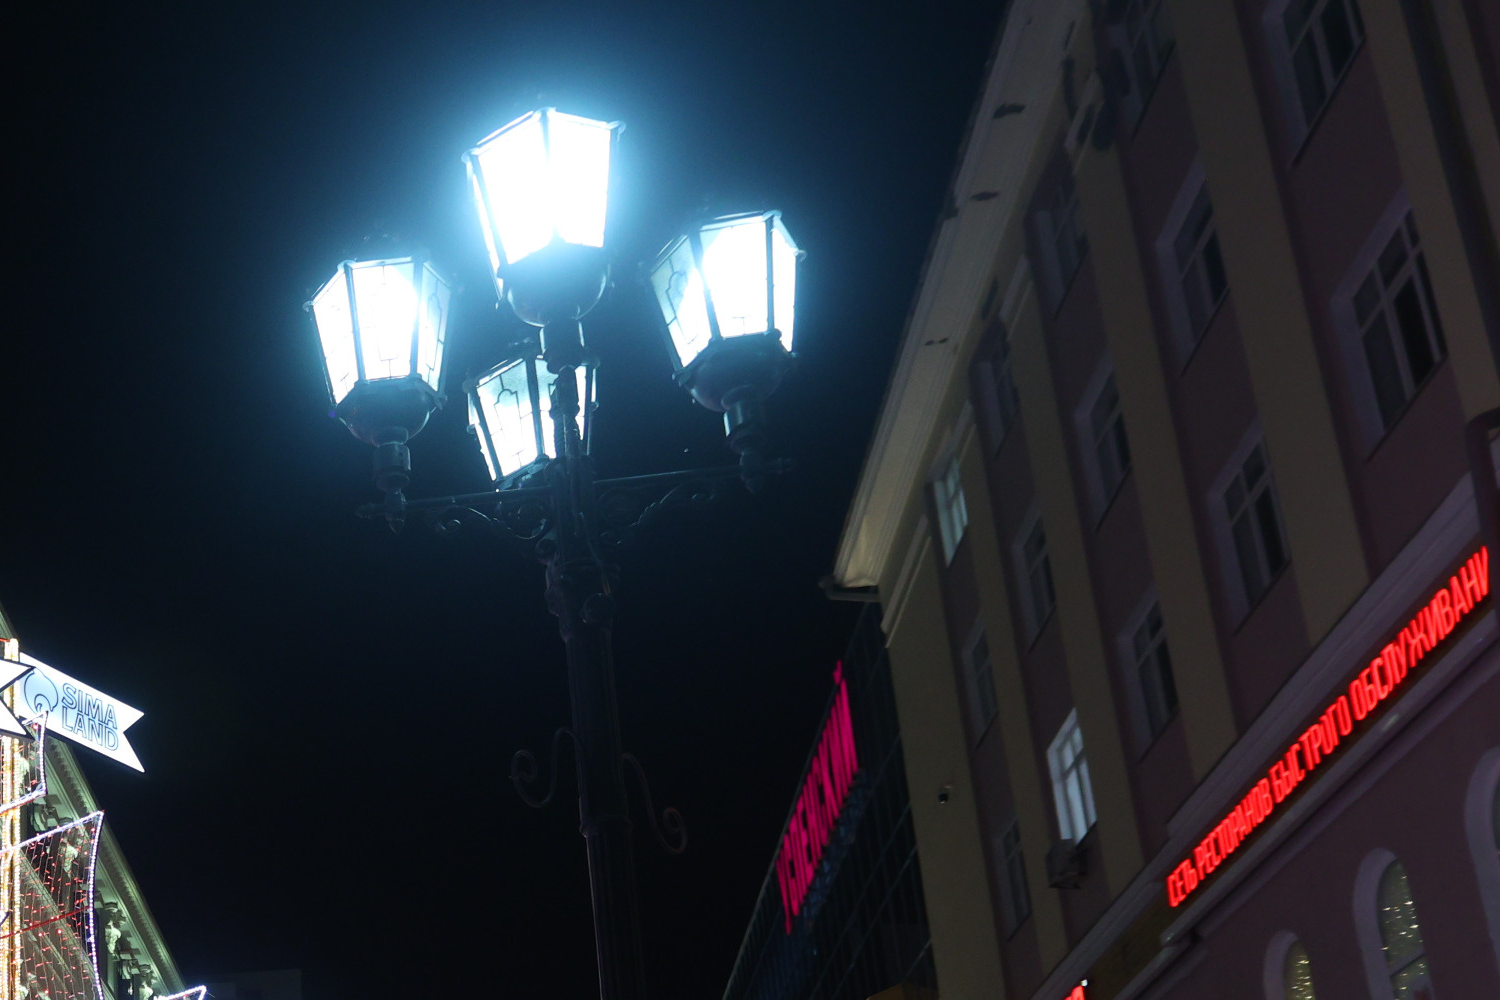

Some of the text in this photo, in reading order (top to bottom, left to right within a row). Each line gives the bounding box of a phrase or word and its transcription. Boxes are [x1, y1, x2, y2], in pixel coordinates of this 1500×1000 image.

[61, 683, 118, 730] SIMA
[61, 707, 119, 751] LAND
[1167, 858, 1198, 908] СЕТЬ
[1193, 777, 1274, 881] РЕСТОРАНОВ
[1269, 695, 1352, 803] БЫСТРОГО
